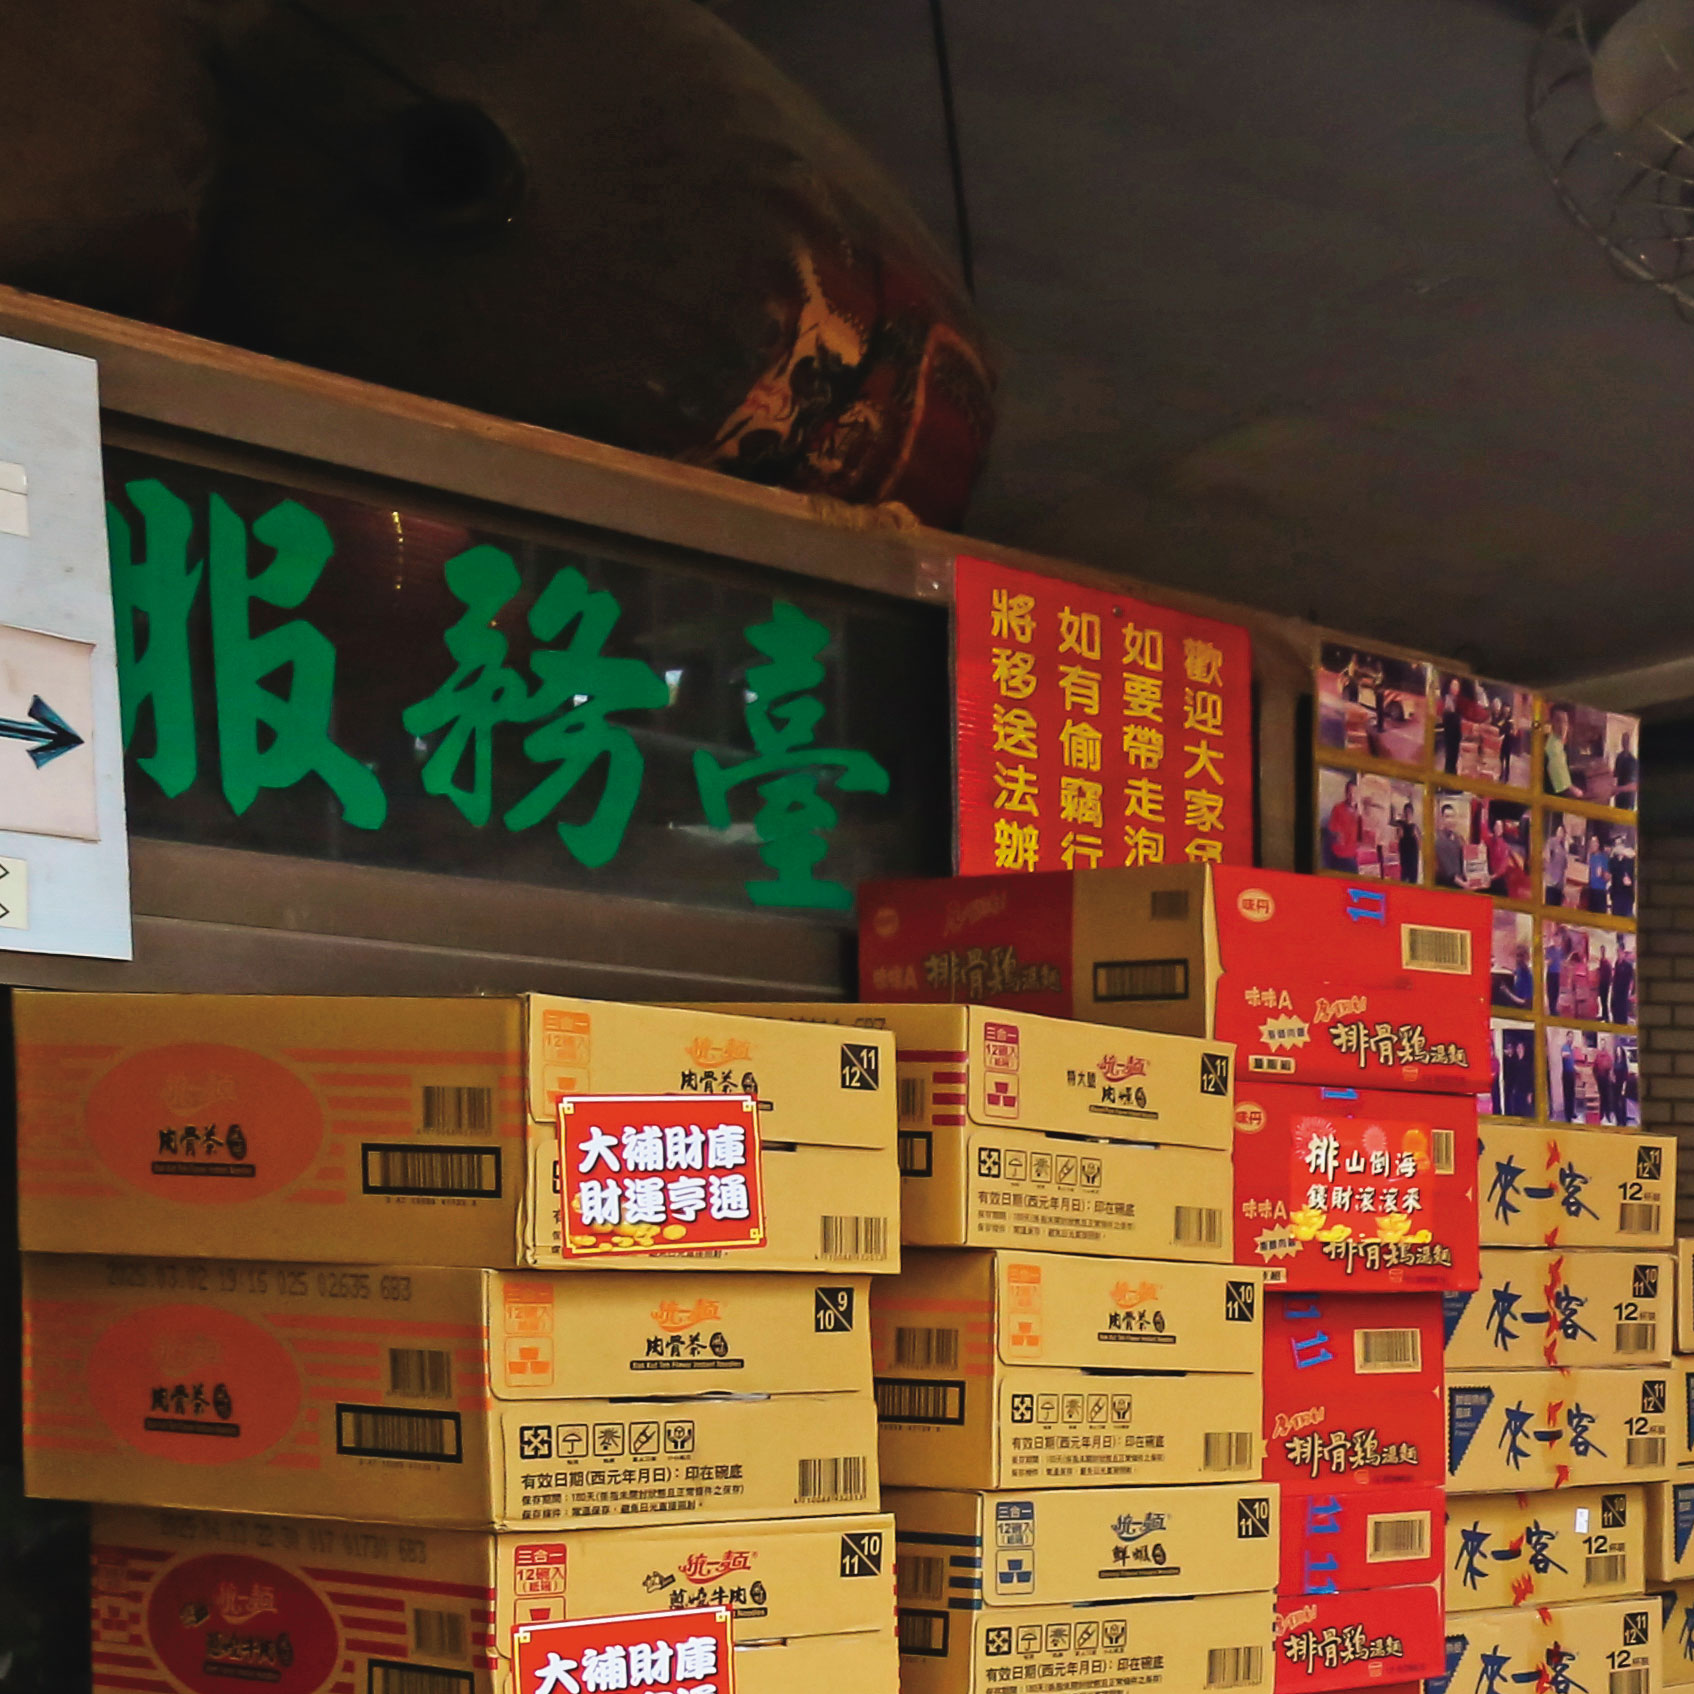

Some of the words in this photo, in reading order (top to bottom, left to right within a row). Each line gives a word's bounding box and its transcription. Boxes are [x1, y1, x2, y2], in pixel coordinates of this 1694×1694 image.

[107, 478, 890, 908] 服務臺
[991, 588, 1040, 872] 將移送法辦
[1058, 605, 1103, 870] 如有偷竊行
[1244, 986, 1293, 1010] 味味A
[859, 1048, 877, 1070] 11
[1215, 1058, 1228, 1077] 11
[841, 1065, 862, 1088] 12
[1201, 1074, 1217, 1092] 12
[577, 1123, 746, 1174] 大補財庫
[1305, 1133, 1418, 1182] 排山倒海
[577, 1173, 751, 1226] 財運亨通
[1306, 1184, 1423, 1214] 錢財滾滾來
[1487, 1154, 1600, 1226] 來一客
[1242, 1198, 1287, 1220] 味味A
[837, 1291, 849, 1313] 9
[1238, 1285, 1253, 1303] 10
[816, 1309, 836, 1332] 10
[1226, 1301, 1239, 1319] 11
[1486, 1280, 1598, 1352] 來一客
[645, 1333, 708, 1358] 肉骨茶
[1498, 1400, 1608, 1471] 來一客
[998, 1505, 1033, 1519] 三合一
[1252, 1501, 1268, 1520] 10
[1110, 1511, 1168, 1542] 統一麵
[1239, 1517, 1253, 1537] 11
[518, 1549, 564, 1565] 三合一
[859, 1535, 880, 1556] 10
[1454, 1519, 1569, 1591] 來一客
[678, 1550, 754, 1584] 統一麵
[842, 1554, 860, 1575] 11
